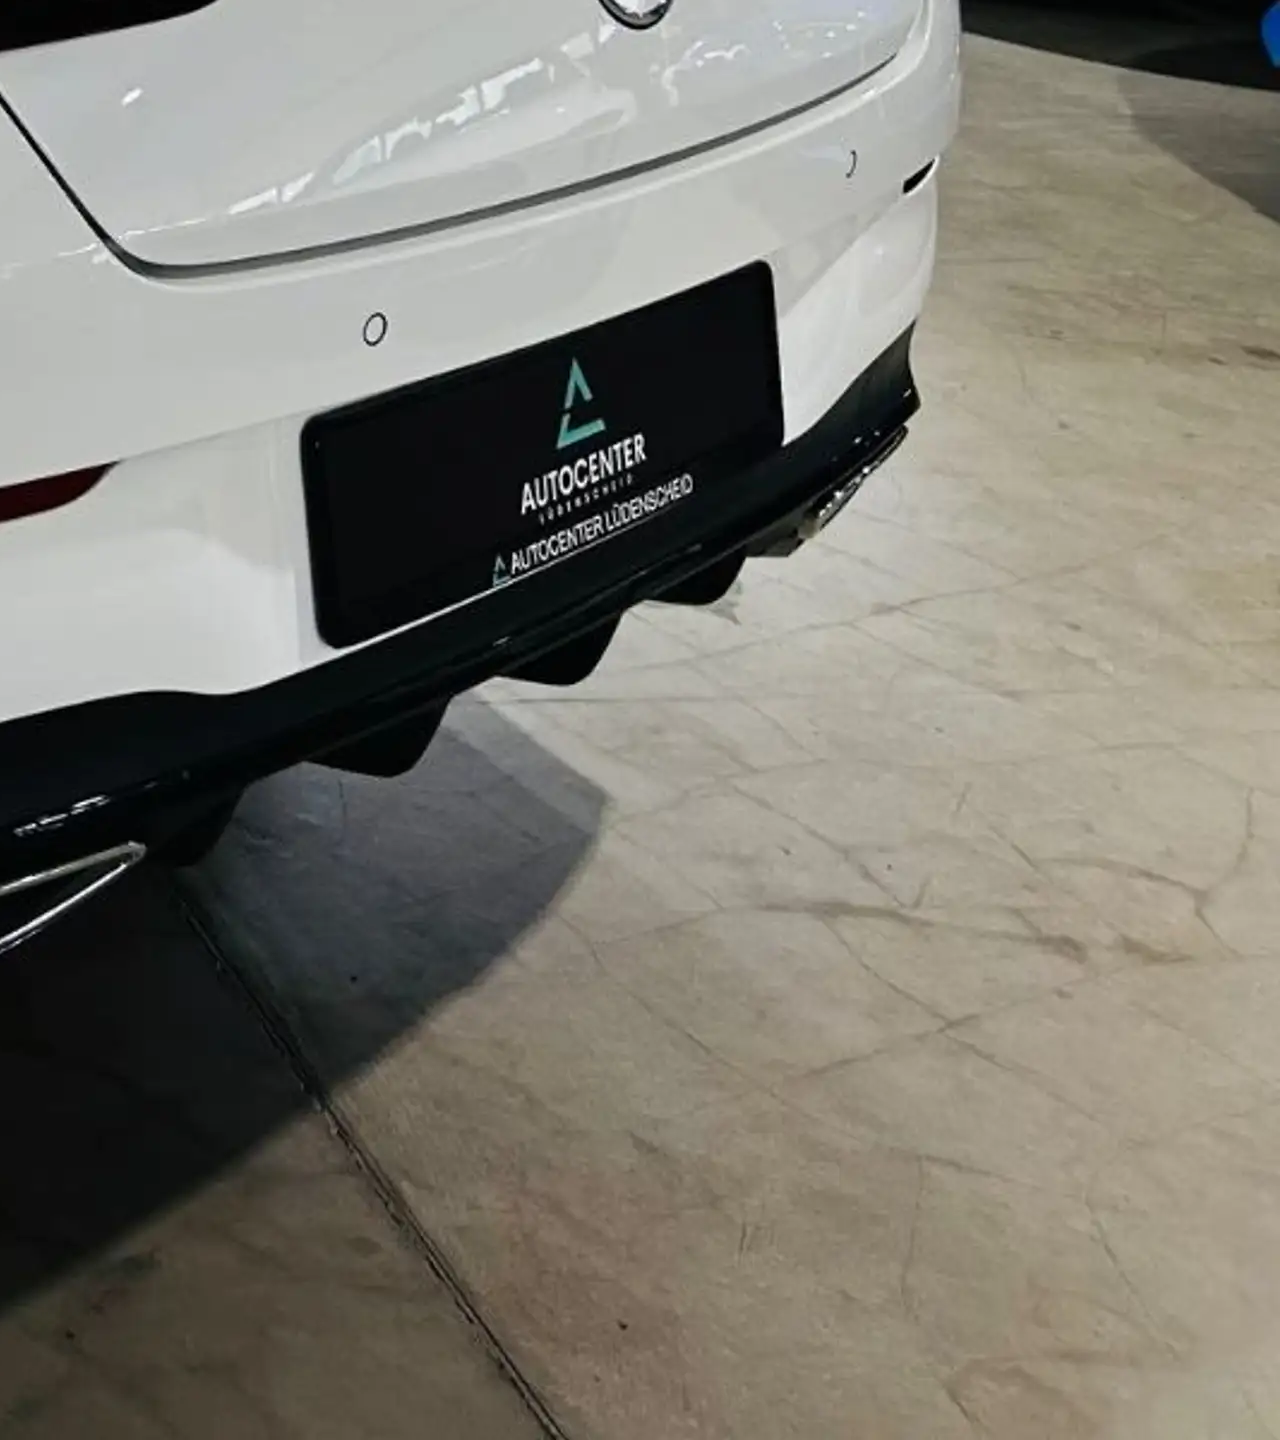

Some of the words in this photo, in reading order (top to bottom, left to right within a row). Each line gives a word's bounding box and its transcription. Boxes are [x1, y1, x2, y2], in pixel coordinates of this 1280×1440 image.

[520, 432, 648, 515] AUTOCENTER
[510, 515, 605, 575] AUTOCENTER
[606, 473, 694, 531] LÜDENSCHEID
